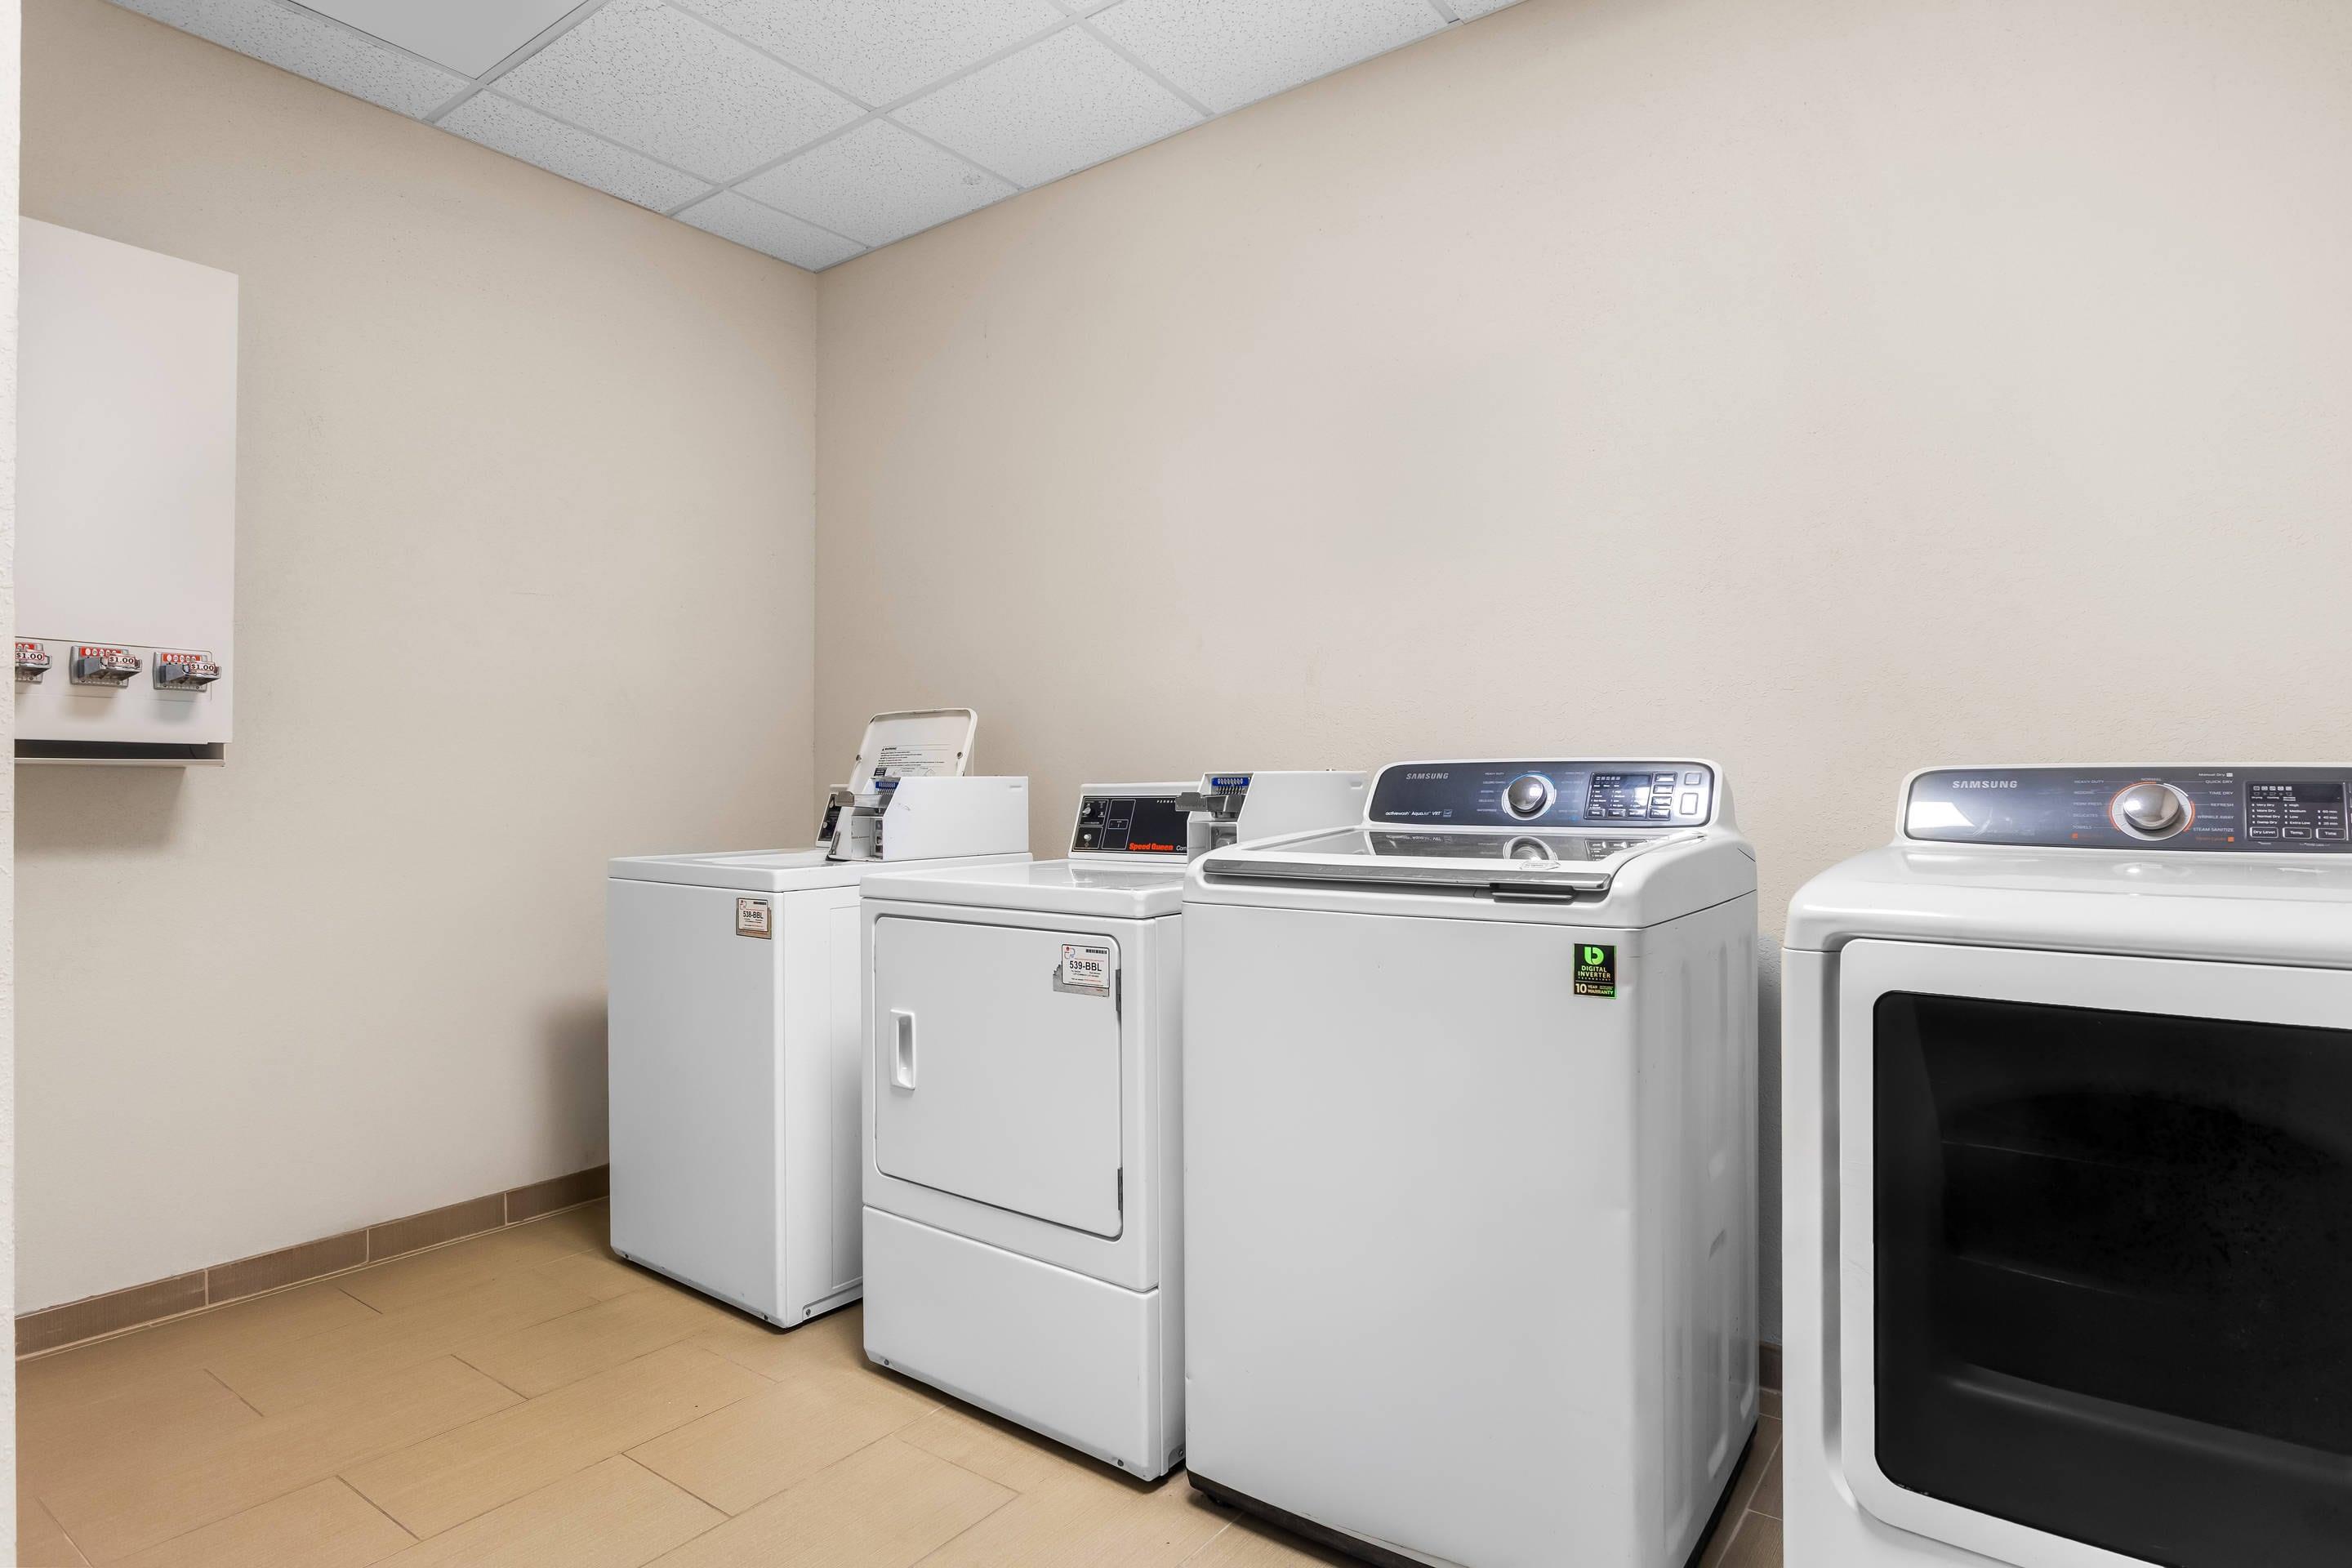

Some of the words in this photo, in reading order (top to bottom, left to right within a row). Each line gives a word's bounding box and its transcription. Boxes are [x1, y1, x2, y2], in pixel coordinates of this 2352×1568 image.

[109, 656, 135, 664] $1.00
[1070, 961, 1102, 971] 539-BBL
[1575, 983, 1587, 993] 10
